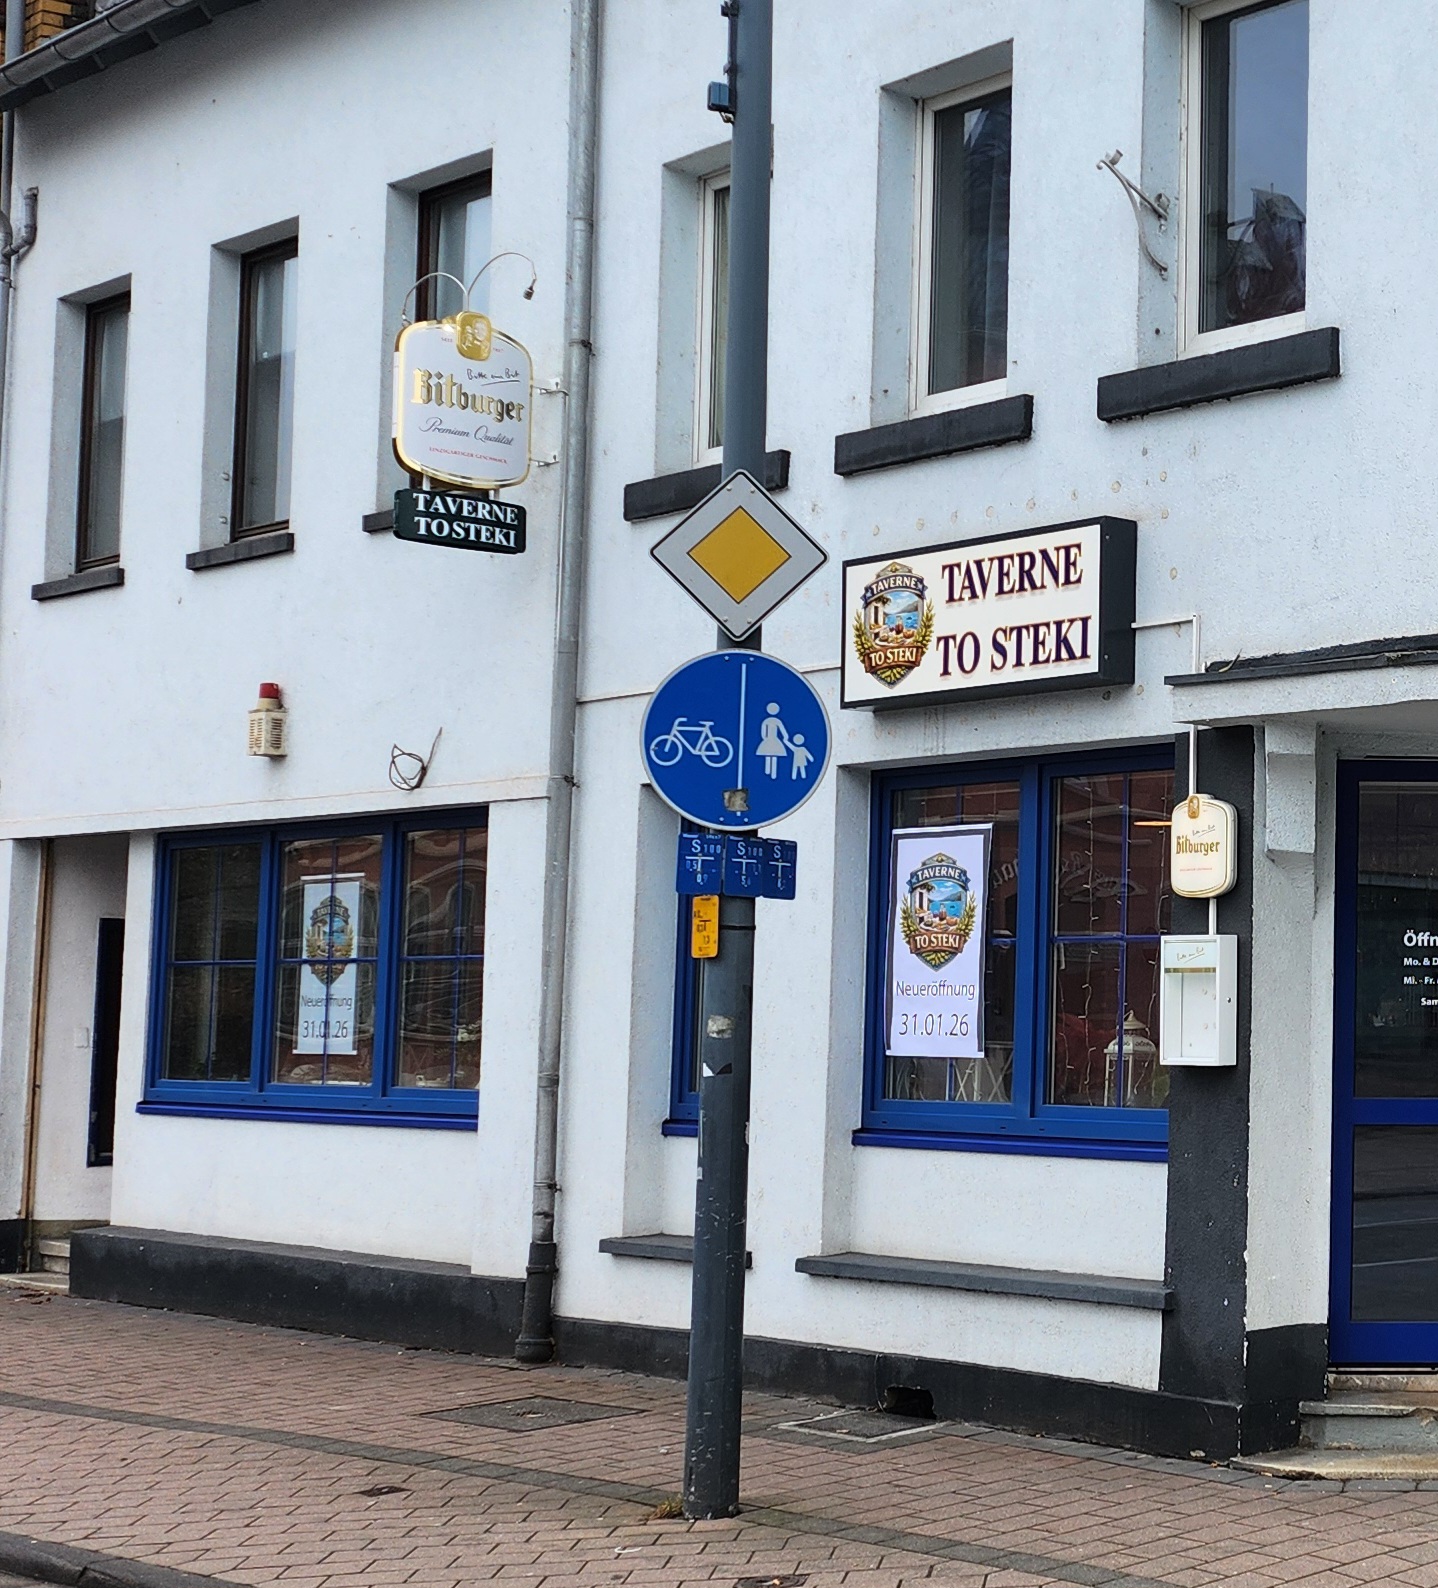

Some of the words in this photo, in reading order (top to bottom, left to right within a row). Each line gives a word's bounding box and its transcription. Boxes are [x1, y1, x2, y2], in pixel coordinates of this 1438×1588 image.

[410, 367, 525, 423] Bitburger
[419, 416, 470, 437] Premium
[412, 492, 519, 525] TAVERNE
[413, 516, 451, 537] TO
[451, 520, 516, 548] STEKI
[941, 542, 1083, 604] TAVERNE
[871, 576, 919, 595] TAVERNE
[936, 631, 981, 677] TO
[990, 615, 1092, 672] STEKI
[869, 652, 884, 667] TO
[886, 647, 917, 663] STEKI
[691, 839, 701, 853] S
[737, 841, 746, 855] S
[773, 845, 782, 858] S
[1176, 835, 1220, 856] Bitburger
[916, 867, 961, 882] TAVERNE
[915, 935, 929, 948] TO
[930, 933, 959, 948] STEKI
[1403, 957, 1422, 967] Mo.
[1422, 957, 1431, 967] &
[896, 979, 975, 1000] Neueröffnung
[1403, 976, 1418, 985] Mi.
[1424, 976, 1436, 985] Fr.
[899, 1013, 969, 1037] 31.01.26
